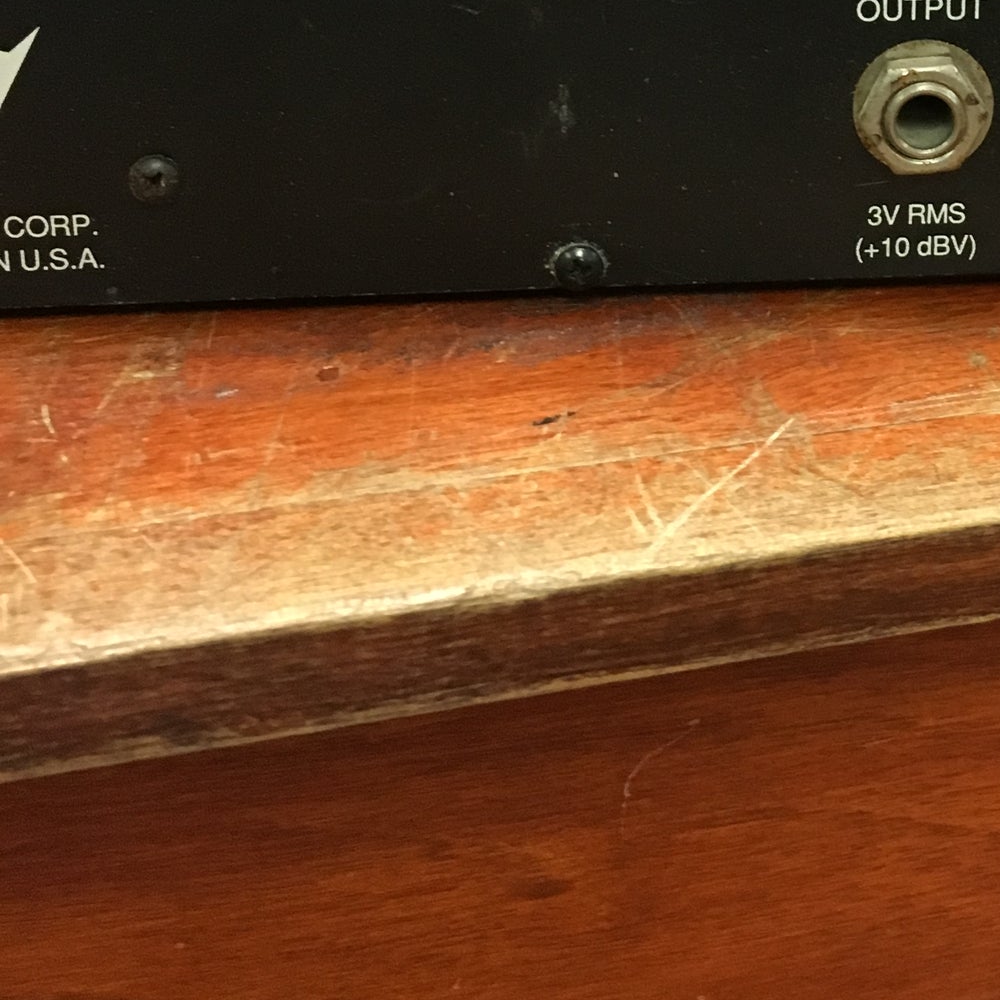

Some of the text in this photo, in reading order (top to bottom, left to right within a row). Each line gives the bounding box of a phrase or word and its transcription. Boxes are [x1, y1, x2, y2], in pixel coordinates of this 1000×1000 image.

[3, 214, 99, 238] CORP.
[867, 203, 967, 226] 3V RMS
[19, 247, 105, 272] U.S.A.
[855, 235, 977, 264] (+10 dBV)
